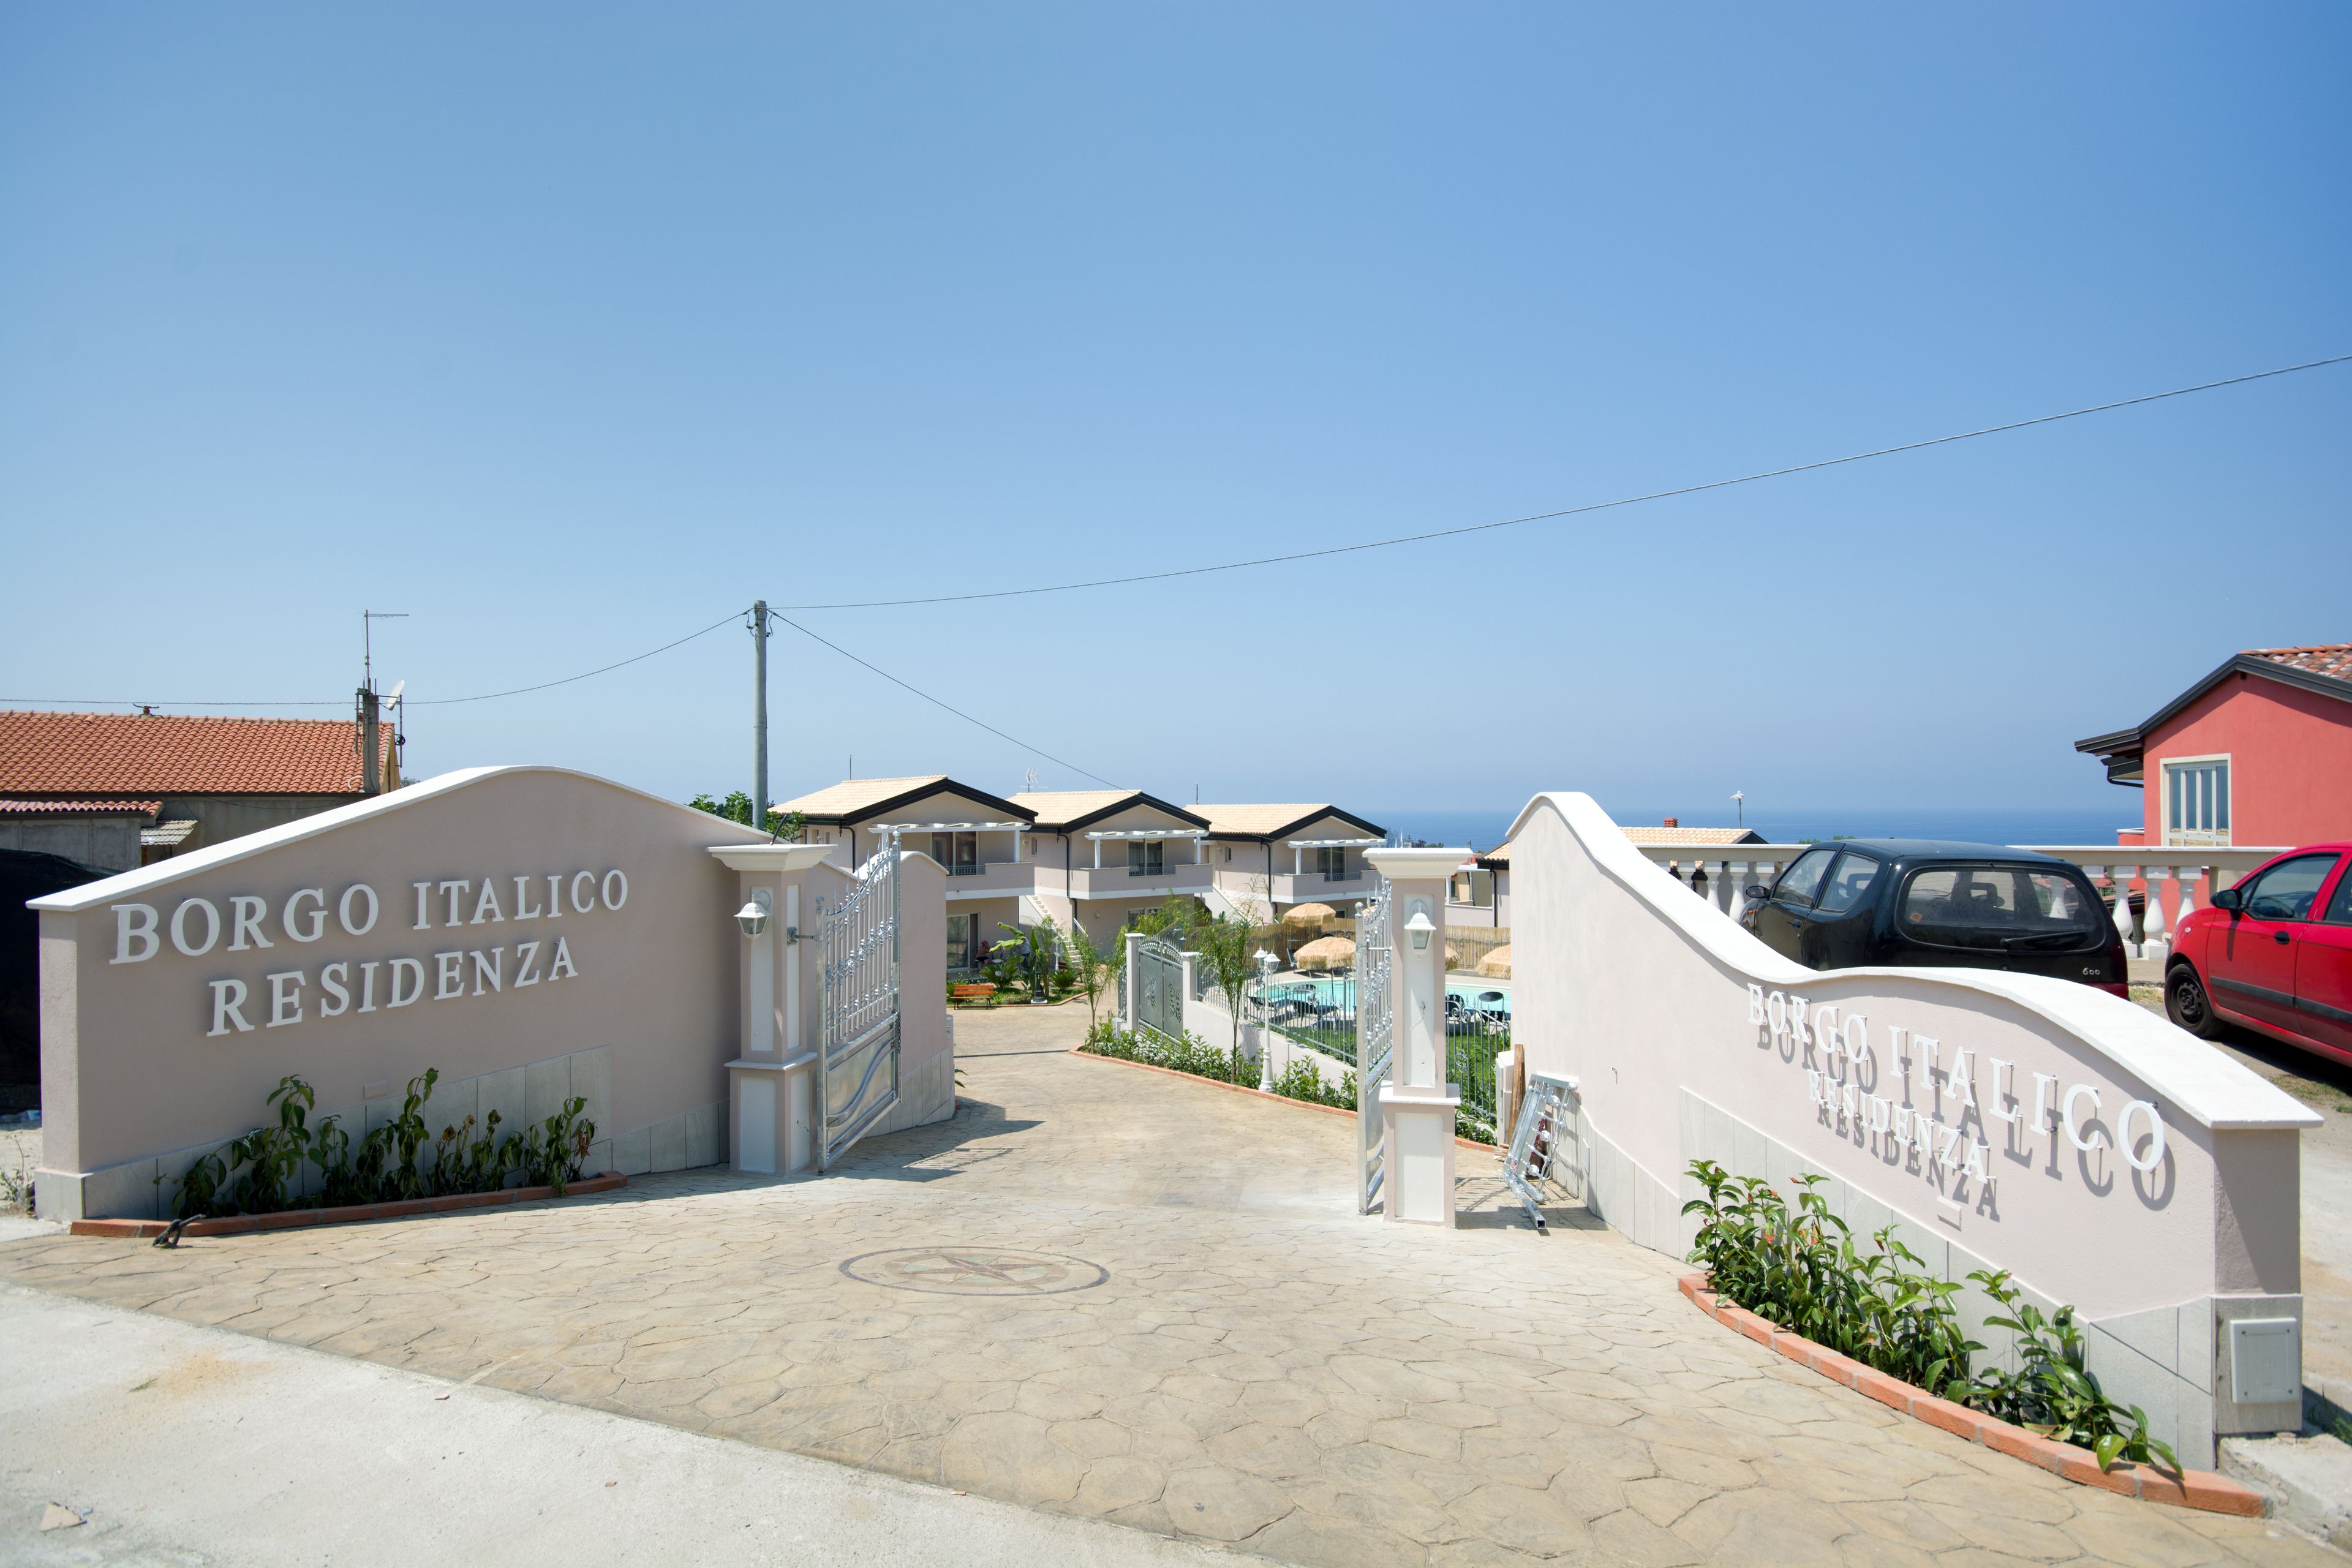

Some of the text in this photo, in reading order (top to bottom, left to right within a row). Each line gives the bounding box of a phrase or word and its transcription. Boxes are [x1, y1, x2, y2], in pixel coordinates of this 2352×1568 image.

[109, 869, 628, 965] BORGO ITALICO
[206, 936, 579, 1037] RESIDENZA
[1747, 982, 2166, 1171] BORGO ITALICO
[1806, 1068, 1989, 1185] RESIDENZA
